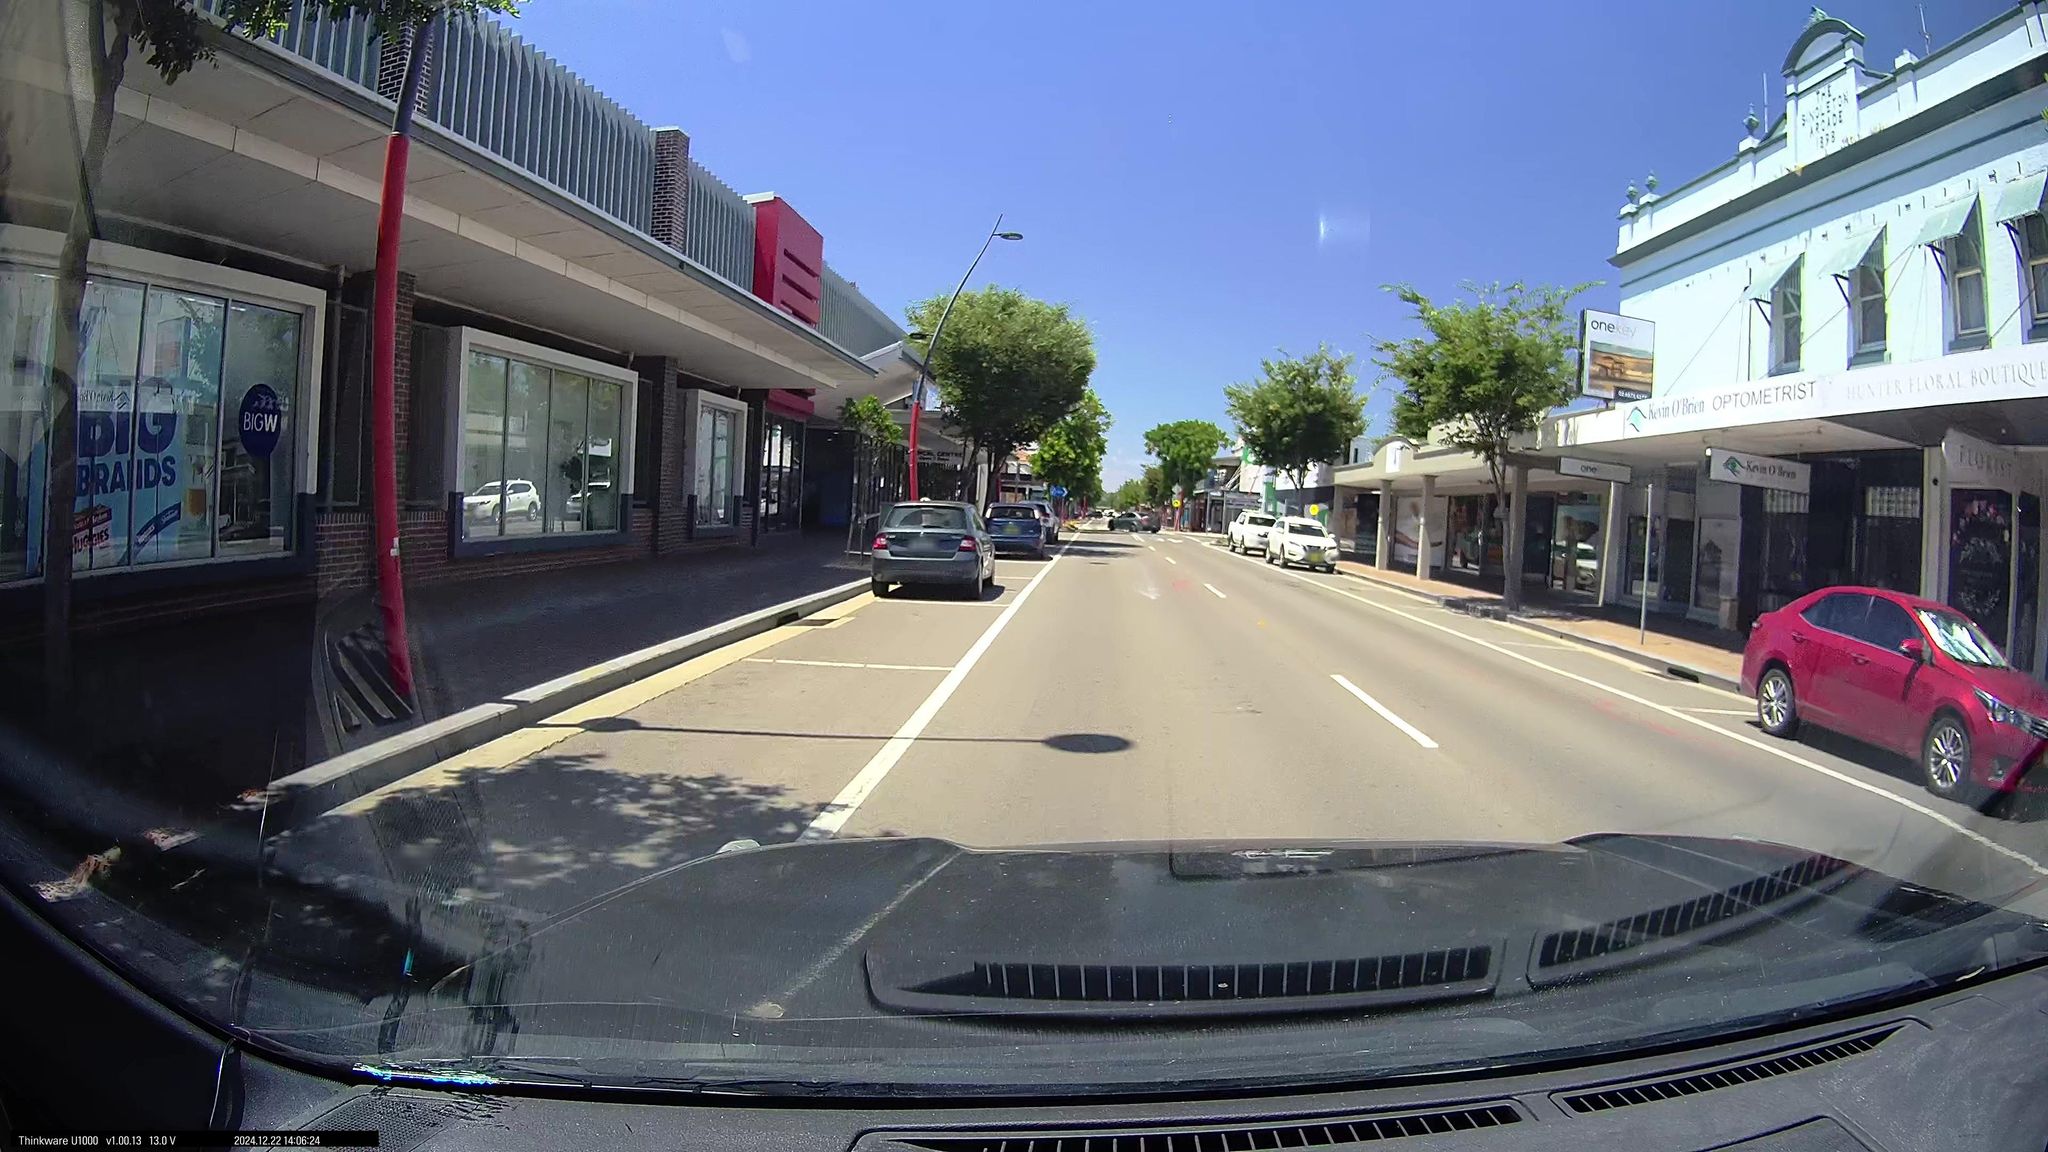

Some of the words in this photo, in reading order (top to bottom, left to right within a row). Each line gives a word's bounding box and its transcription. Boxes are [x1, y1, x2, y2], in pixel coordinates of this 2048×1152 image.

[1802, 91, 1849, 127] SINGLETON
[1809, 110, 1842, 138] ARCADE
[1649, 402, 1670, 420] Kevin
[1672, 397, 1705, 418] O'Brien
[1712, 380, 1816, 411] OPTOMETRIST
[1847, 380, 1903, 400] HUNTER
[1909, 371, 1962, 394] FLORAL
[1971, 360, 2048, 388] BOUTIQUE
[79, 377, 177, 457] BIG
[77, 455, 176, 497] BRANDS
[1959, 445, 2013, 480] FLORIST
